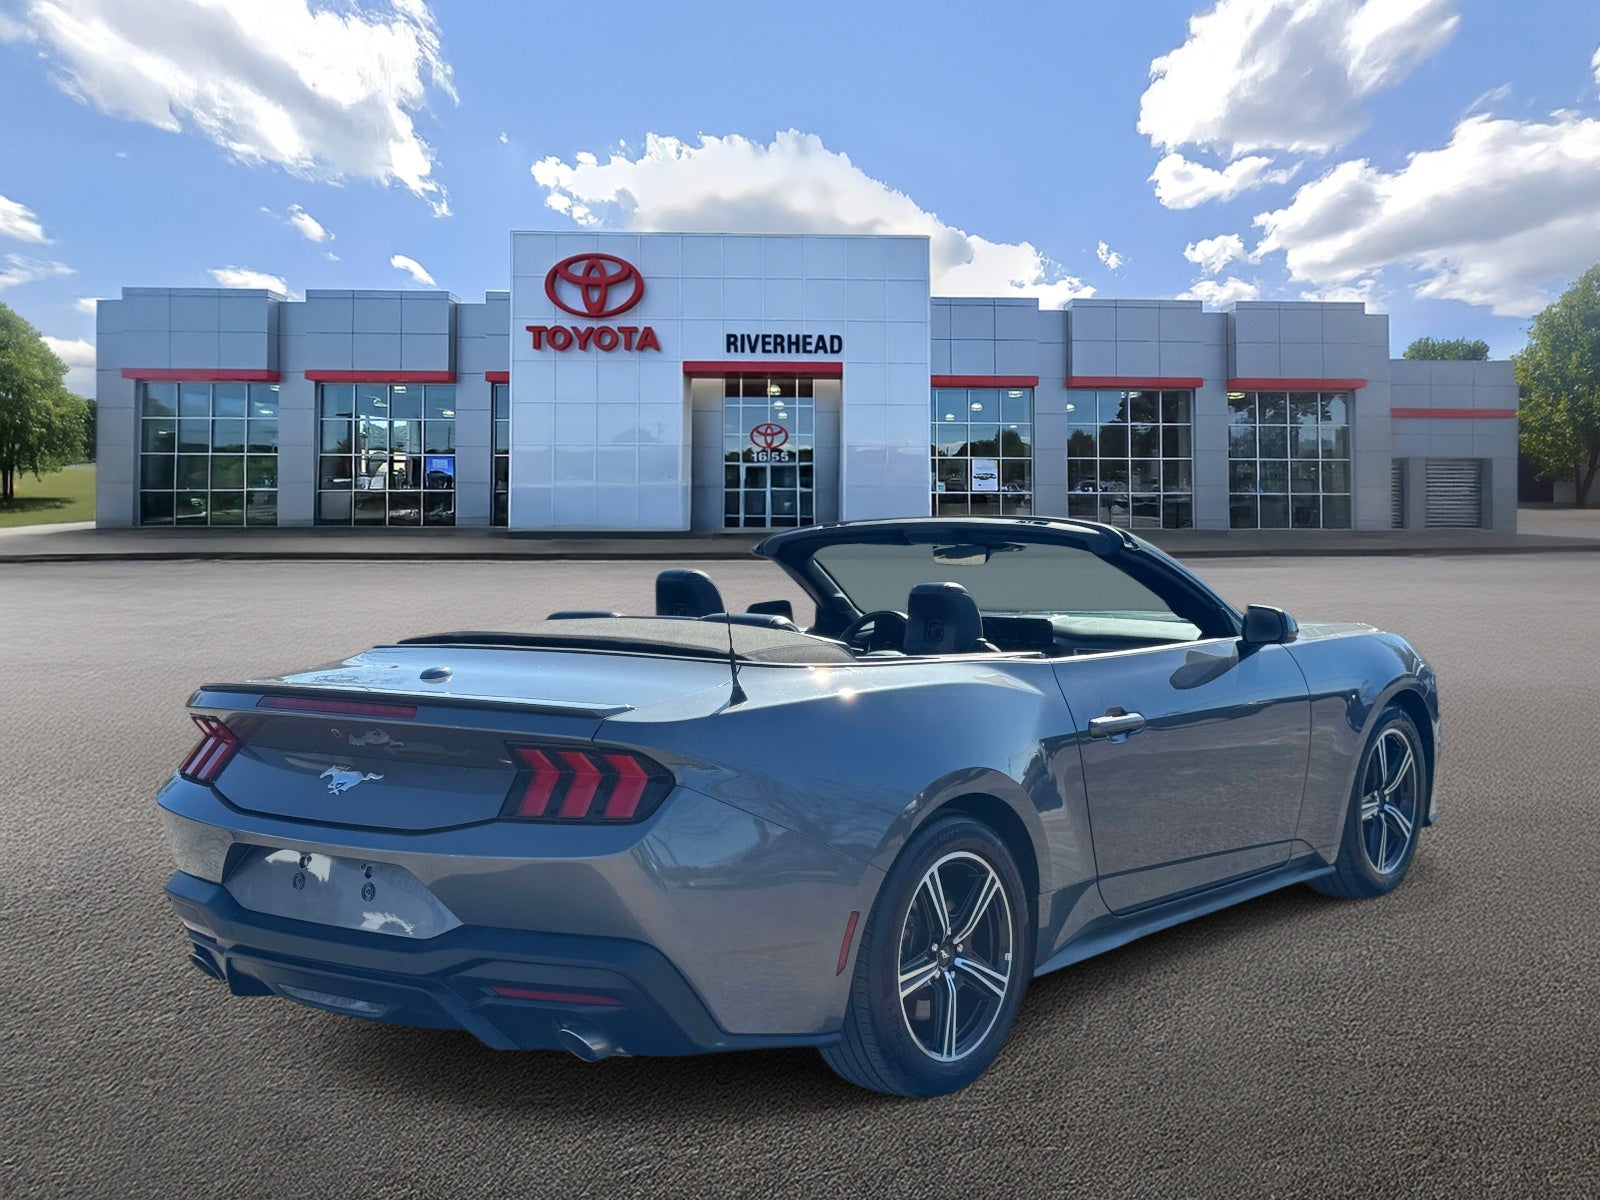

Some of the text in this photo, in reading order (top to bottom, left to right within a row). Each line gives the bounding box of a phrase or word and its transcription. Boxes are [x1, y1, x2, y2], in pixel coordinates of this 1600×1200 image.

[526, 325, 660, 352] TOYOTA
[726, 333, 843, 354] RIVERHEAD
[751, 451, 789, 462] 1655
